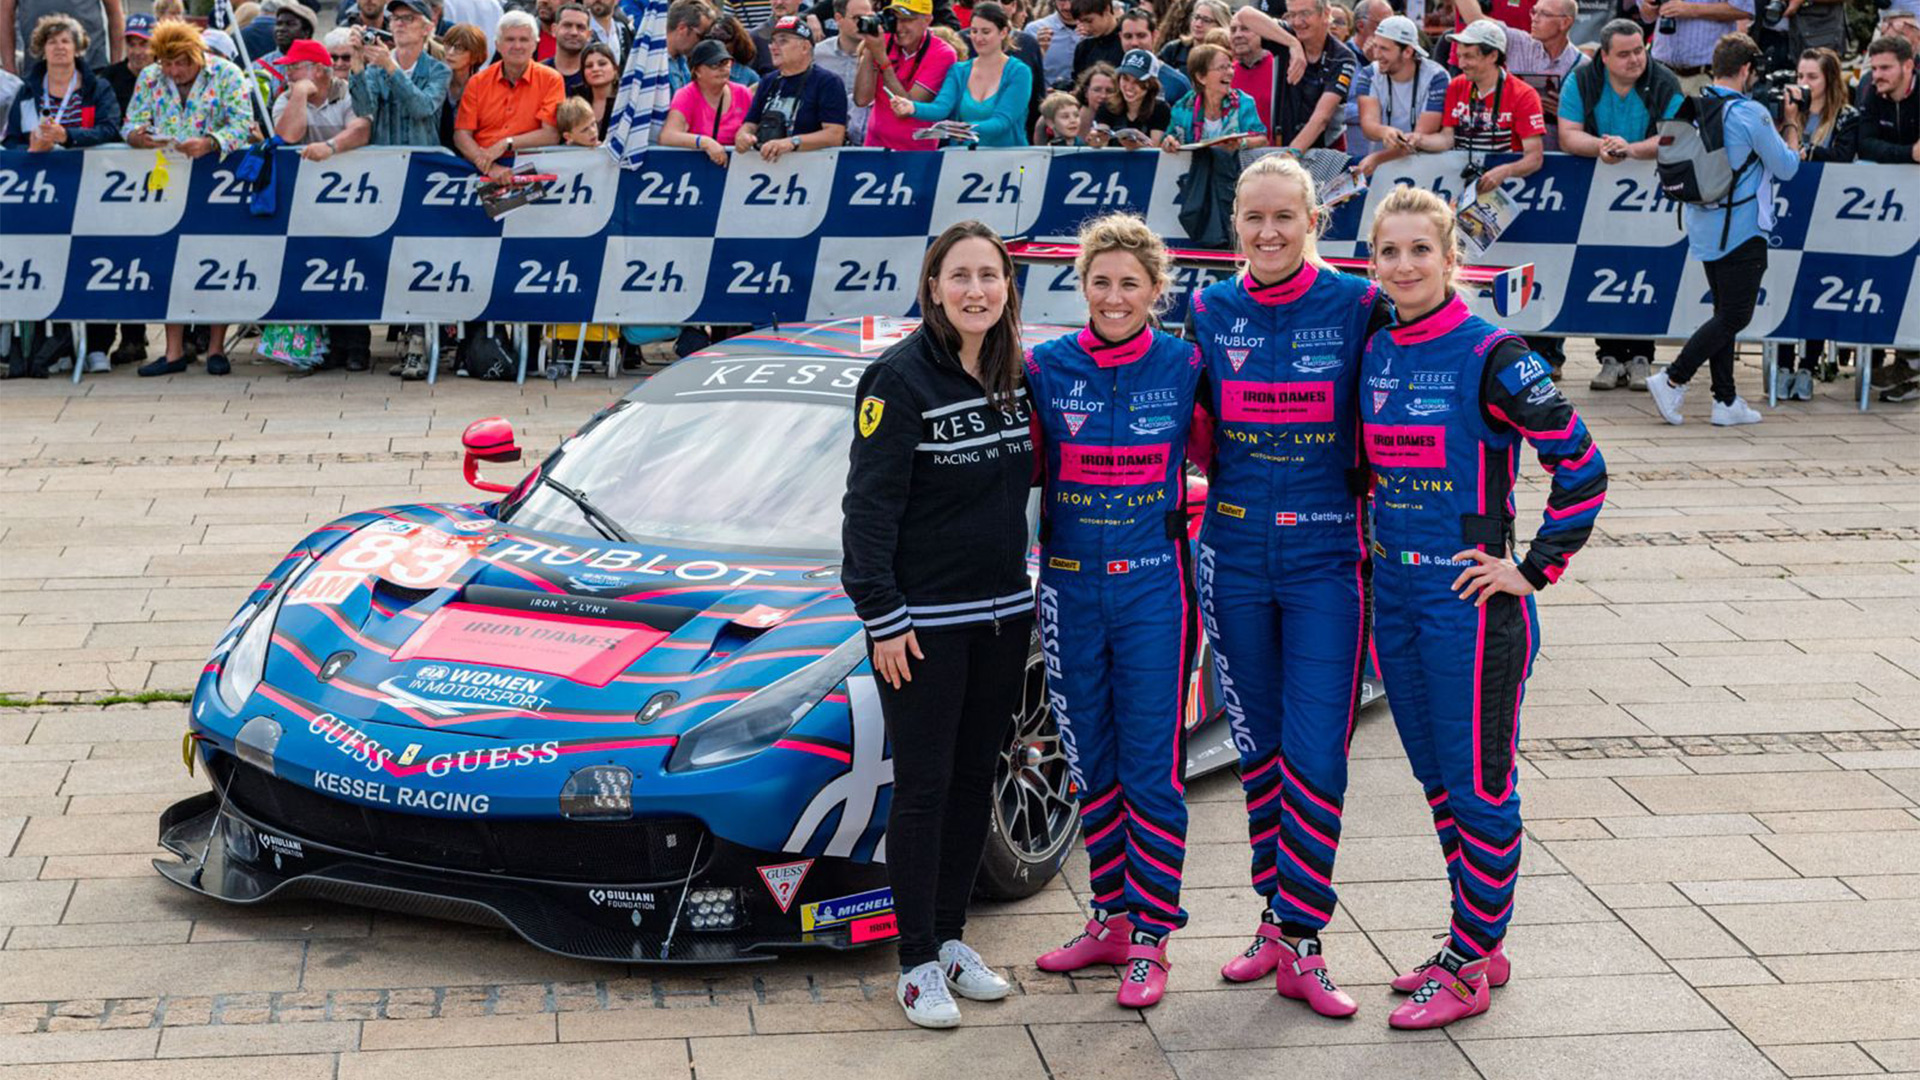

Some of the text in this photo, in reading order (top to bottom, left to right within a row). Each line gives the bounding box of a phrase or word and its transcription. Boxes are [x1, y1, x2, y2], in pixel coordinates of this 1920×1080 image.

[0, 170, 56, 203] 24h
[207, 170, 252, 203] 24
[315, 172, 379, 204] 24h
[636, 172, 700, 205] 24h
[744, 173, 807, 206] 24h
[849, 172, 913, 206] 24h
[957, 172, 1020, 203] 24h
[1063, 171, 1128, 204] 24h
[1503, 177, 1563, 211] 24h
[1836, 186, 1903, 221] 24h
[85, 257, 151, 291] 24h
[194, 259, 257, 291] 24h
[301, 258, 366, 291] 24h
[408, 260, 470, 292] 24h
[514, 260, 578, 293] 24h
[621, 260, 684, 292] 24h
[726, 261, 791, 294] 24h
[834, 259, 898, 292] 24h
[1587, 268, 1655, 304] 24h
[1812, 275, 1881, 313] 24h
[1214, 333, 1265, 348] HUBLOT
[1295, 330, 1340, 340] KESSEL
[1413, 374, 1452, 383] KESSEL
[1514, 355, 1542, 379] 24h
[1052, 398, 1105, 412] HUBLOT
[1133, 391, 1175, 403] KESSEL
[1243, 391, 1326, 404] IRON DAMES
[1223, 429, 1336, 444] IRON LYNX
[1397, 435, 1436, 447] DAMES
[934, 451, 980, 465] RACING
[1081, 453, 1163, 467] IRON DAMES
[1250, 453, 1289, 463] MOTORSPORT
[1057, 488, 1165, 507] IRON LYNX
[1413, 480, 1453, 492] LYNX
[1079, 518, 1121, 526] MOTORSPORT
[1299, 513, 1309, 522] M.
[1311, 512, 1342, 523] Gatting
[338, 534, 461, 585] 83
[484, 543, 777, 587] HUBLOT
[1130, 560, 1140, 570] R.
[1141, 556, 1160, 567] Frey
[1421, 555, 1432, 565] M.
[295, 576, 353, 599] AM
[530, 598, 608, 615] IRON LYNX
[463, 621, 529, 637] IRON
[531, 628, 622, 650] DAMES
[1040, 582, 1063, 680] KESSEL
[1200, 543, 1257, 753] KESSEL RACING
[408, 679, 552, 711] IN MOTORSPORT
[417, 666, 544, 693] FIA WOMEN
[308, 713, 394, 772] GUESS
[1050, 688, 1088, 792] RACING
[425, 740, 560, 778] GUESS
[314, 770, 489, 814] KESSEL RACING
[270, 835, 302, 851] GIULIANI
[766, 865, 803, 880] GUESS
[606, 890, 655, 902] GIULIANI
[607, 900, 655, 910] FOUNDATION
[869, 922, 892, 933] IRON
